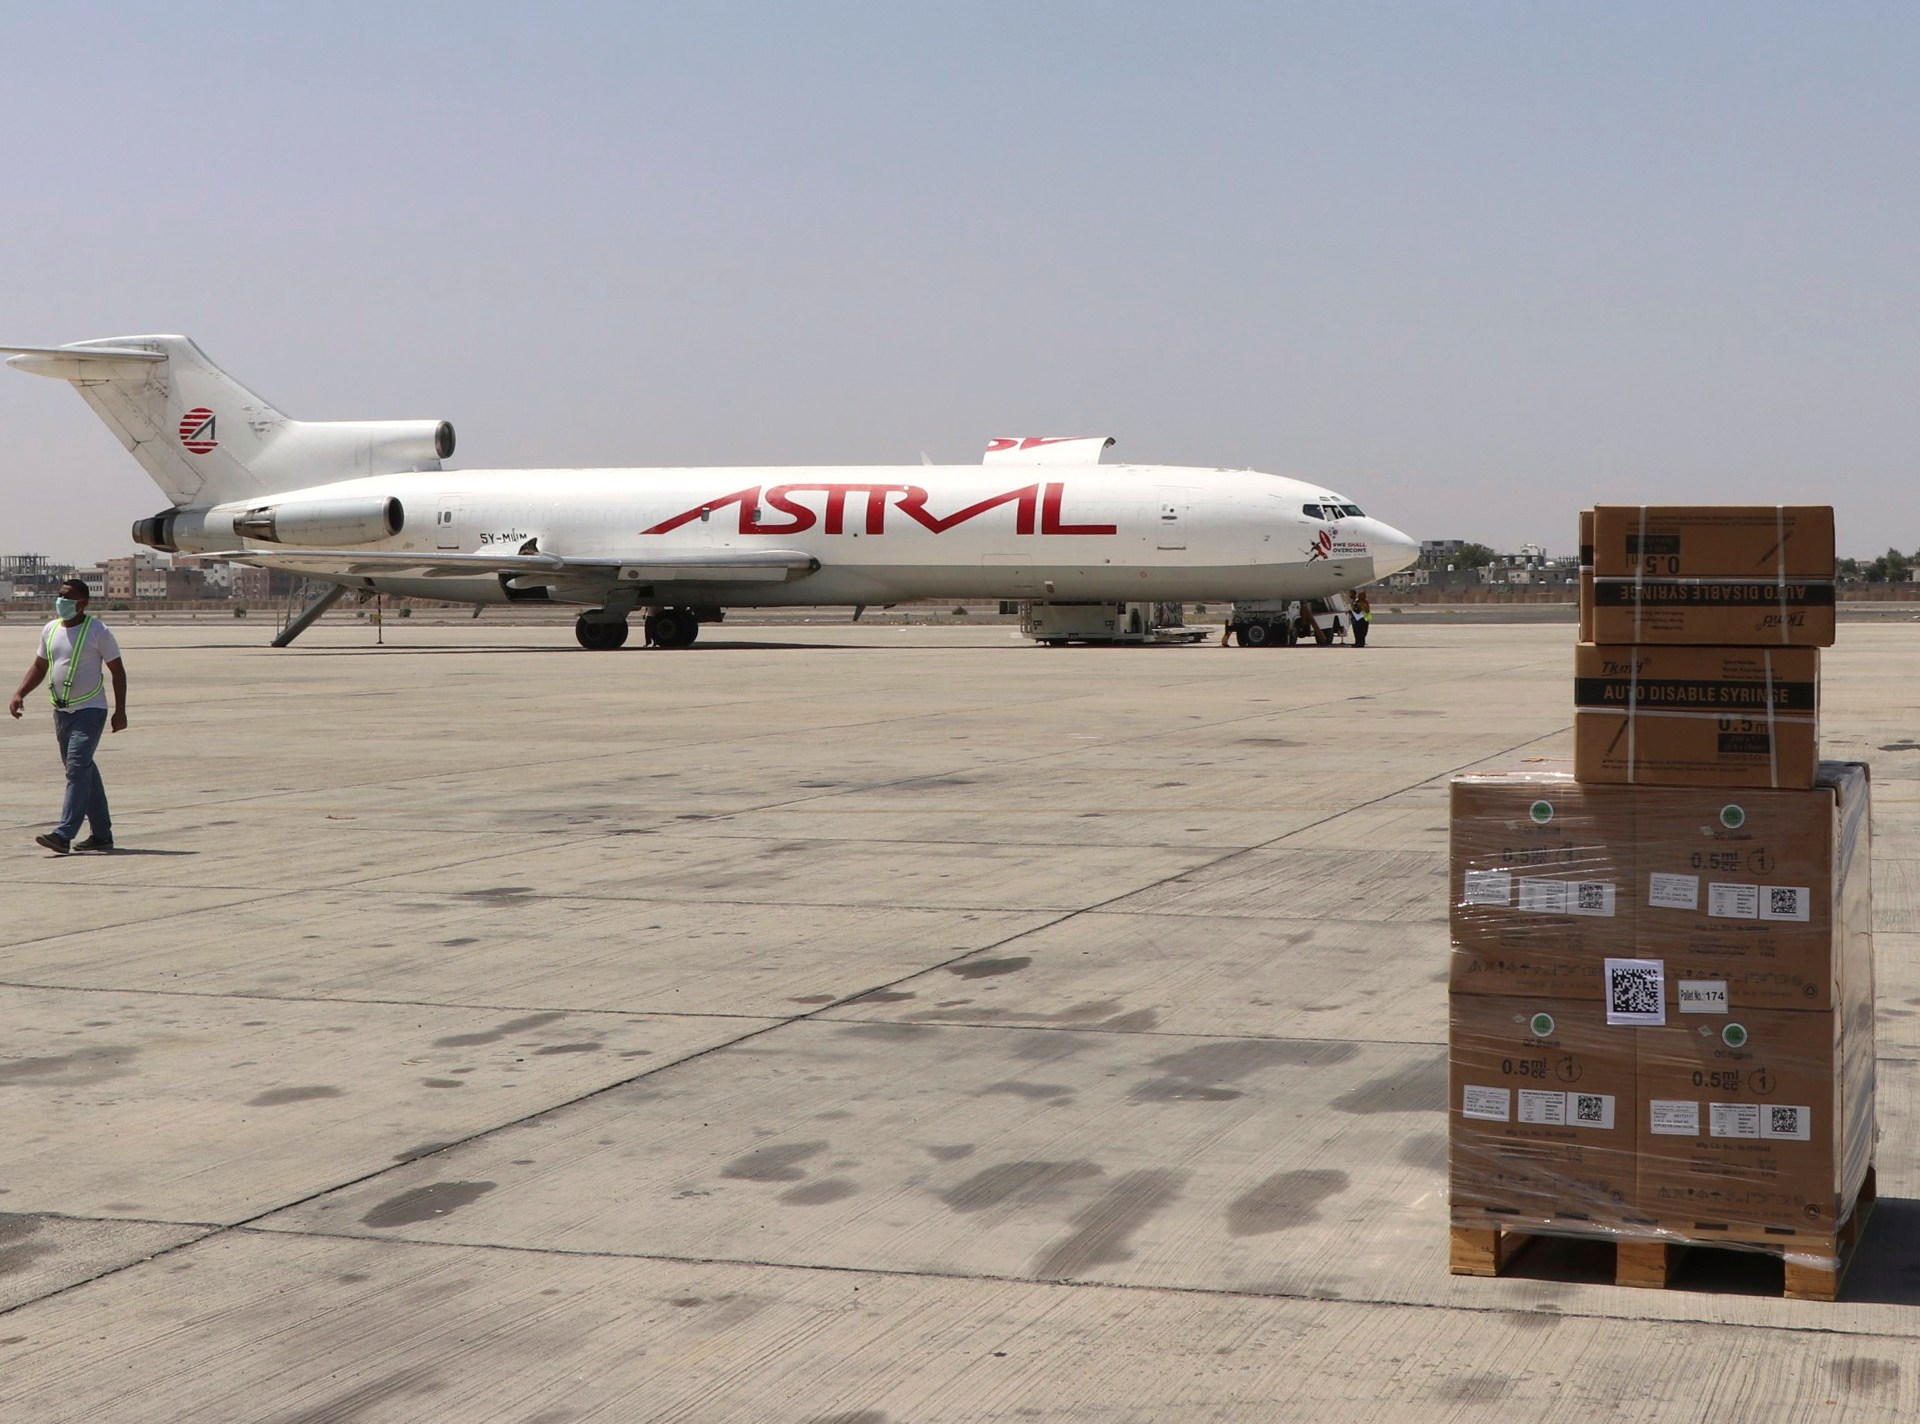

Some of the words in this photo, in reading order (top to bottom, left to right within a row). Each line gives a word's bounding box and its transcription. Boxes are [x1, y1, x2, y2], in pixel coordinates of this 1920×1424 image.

[639, 483, 1117, 535] ASTRAL
[1646, 555, 1680, 574] 0.5
[1620, 585, 1687, 600] SYRINGE
[1693, 585, 1759, 600] DISABLE
[1764, 585, 1806, 600] AUTO
[1650, 686, 1715, 701] DISABLE
[1720, 687, 1789, 703] SYRINGE
[1718, 718, 1753, 732] 0.5
[1691, 852, 1720, 869] 0.5
[1721, 851, 1738, 860] ml
[1706, 991, 1725, 1001] 174
[1502, 1059, 1530, 1075] 0.5
[1531, 1058, 1547, 1068] ml
[1531, 1070, 1546, 1079] cc
[1692, 1071, 1720, 1088] 0.5
[1722, 1069, 1739, 1080] ml
[1722, 1081, 1738, 1091] cc
